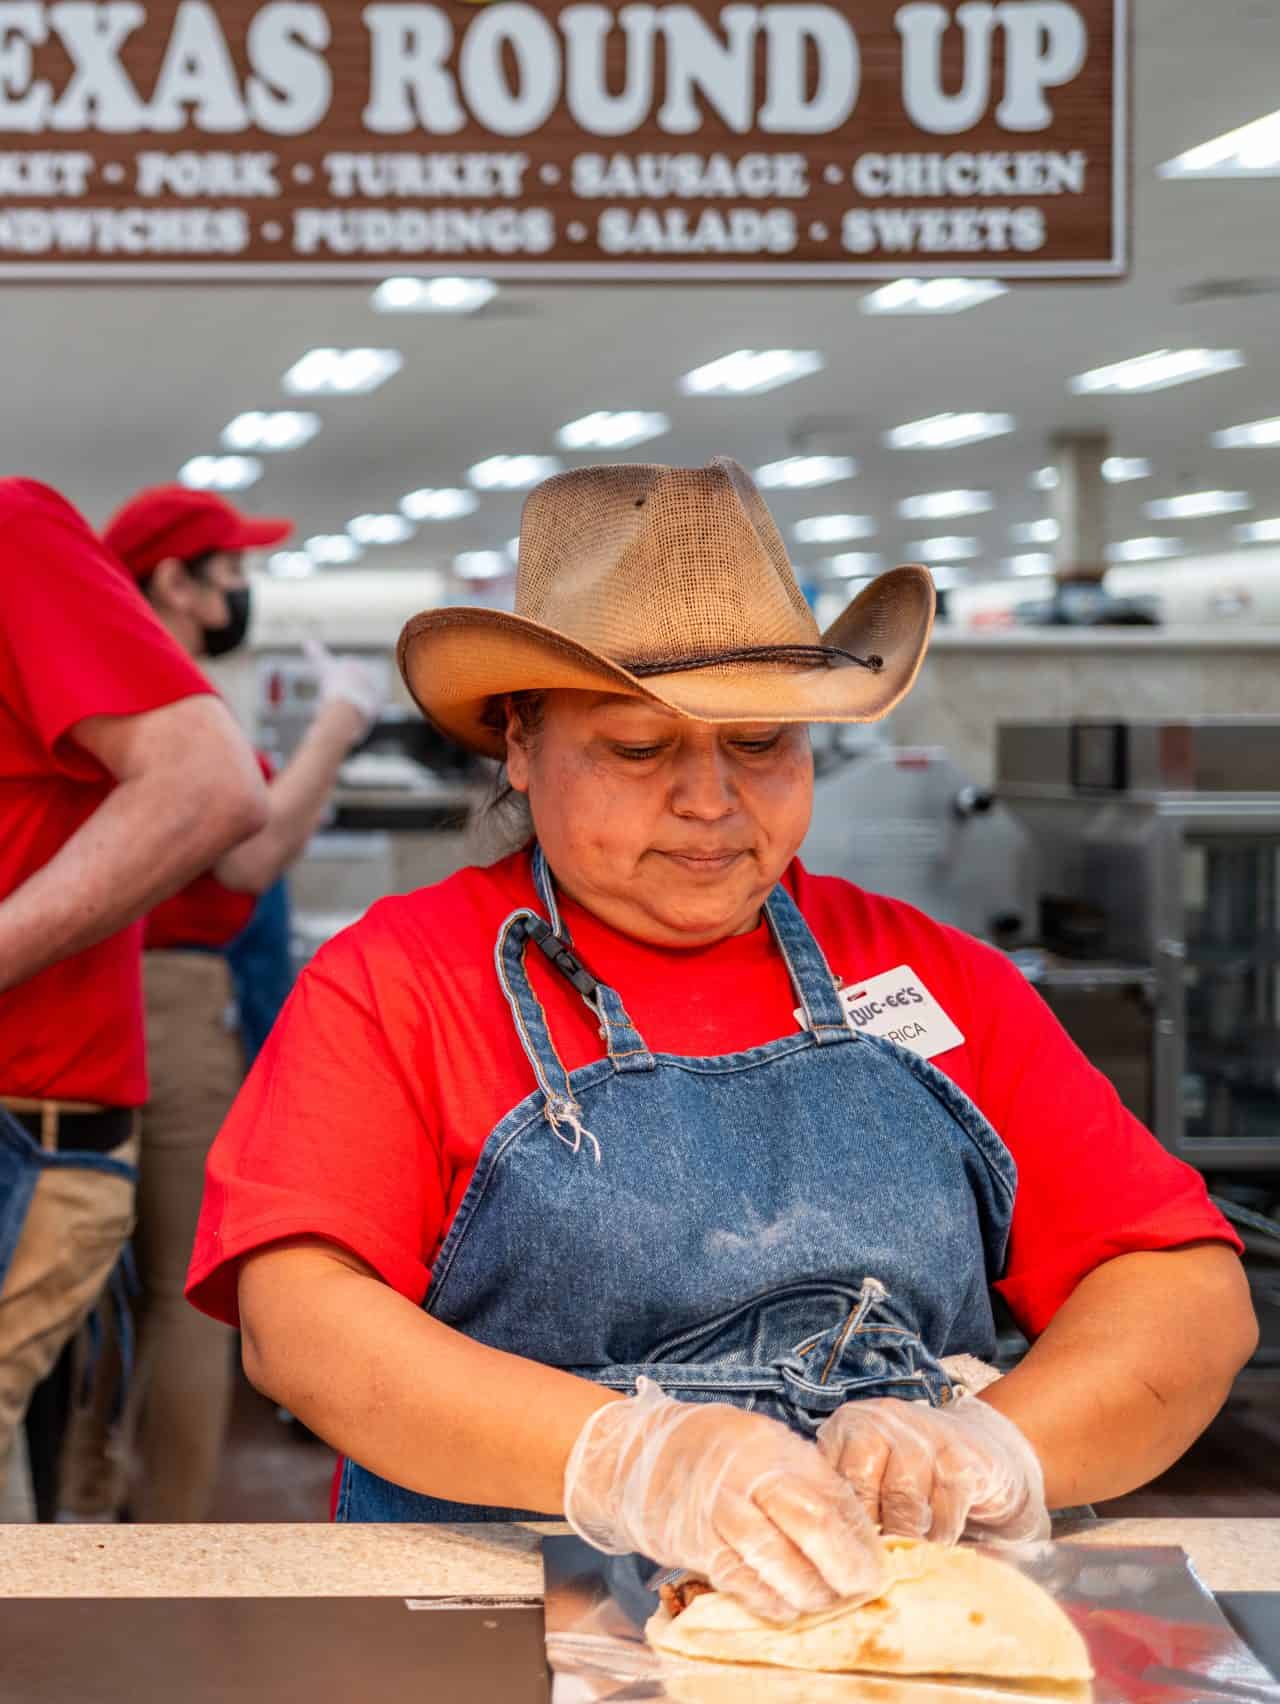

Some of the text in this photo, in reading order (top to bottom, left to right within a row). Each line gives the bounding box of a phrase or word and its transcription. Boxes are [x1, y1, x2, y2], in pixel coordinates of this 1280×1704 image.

[364, 3, 859, 135] ROUND
[896, 0, 1085, 133] UP
[137, 152, 278, 196] PORK
[324, 153, 527, 196] TURKEY
[573, 154, 808, 197] SAUSAGE
[854, 152, 1084, 196] CHICKEN
[294, 209, 553, 252] PUDDINGS
[600, 209, 796, 252] SALADS
[843, 208, 1043, 252] SWEETS
[881, 1022, 927, 1043] RICA
